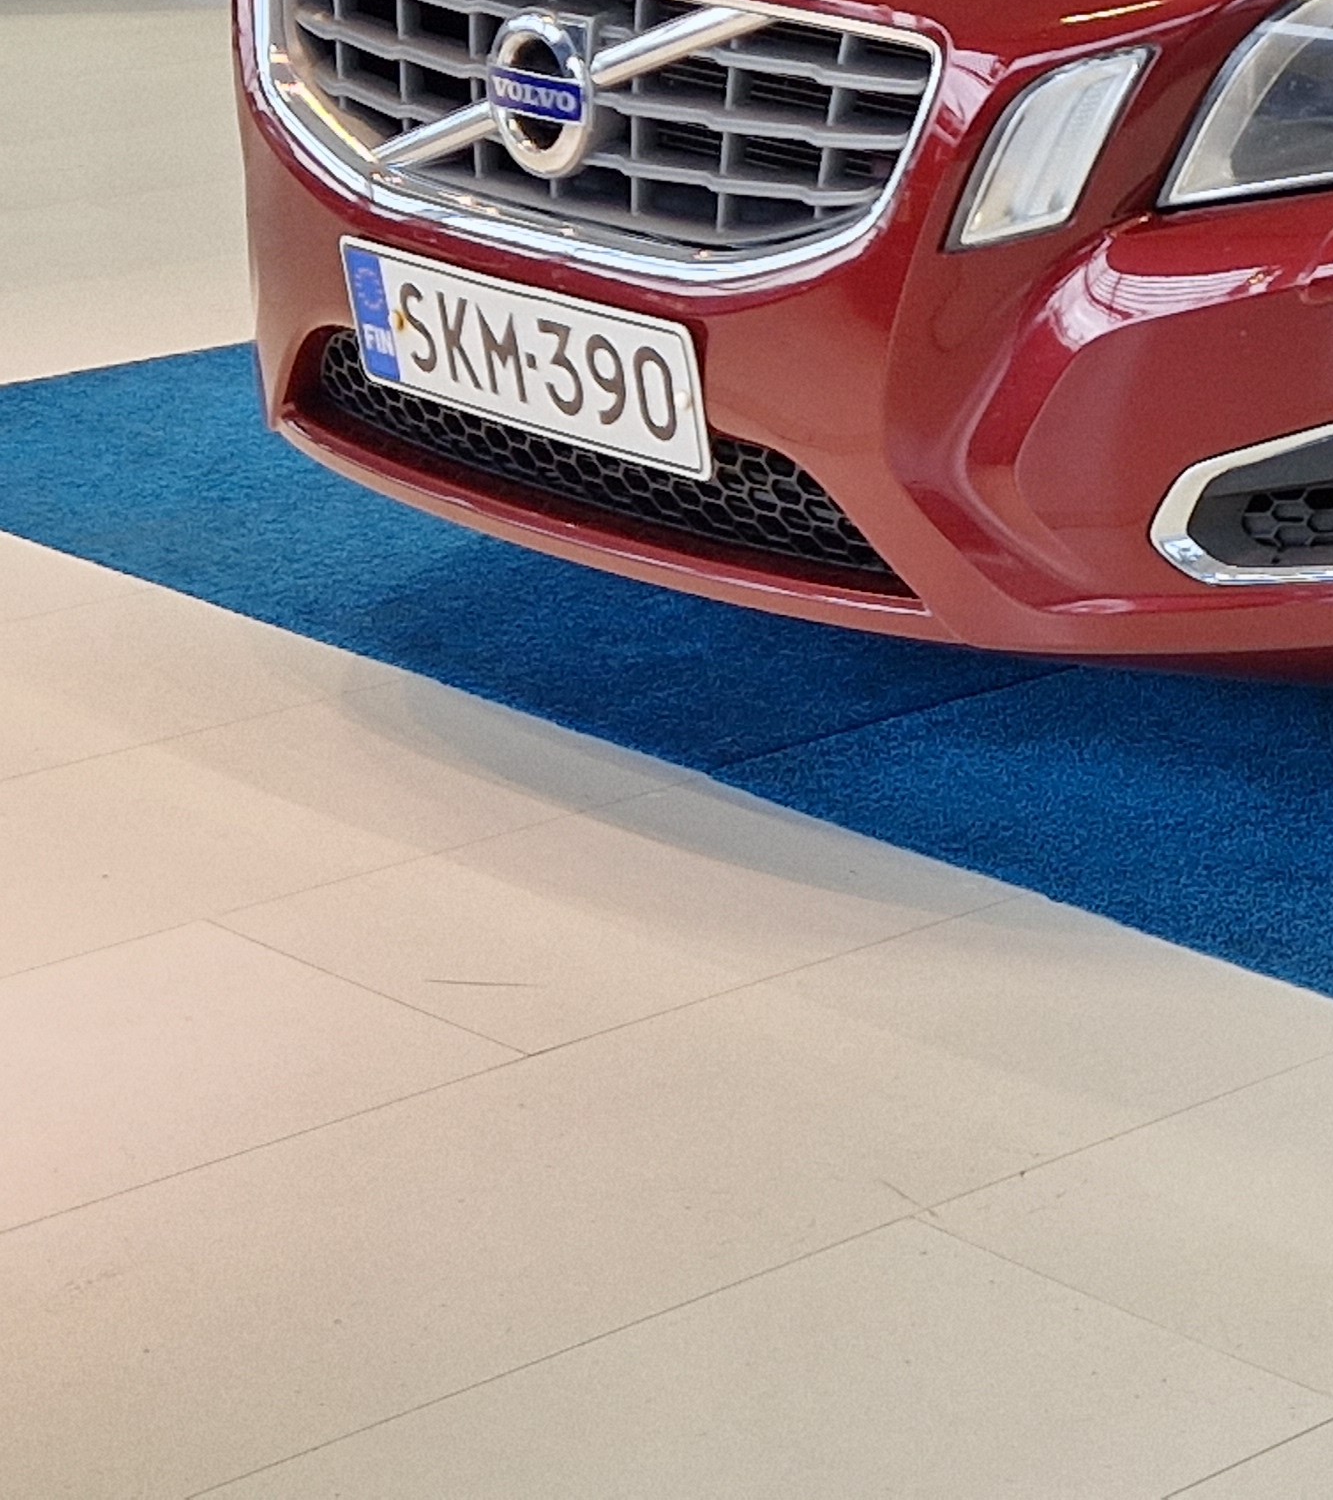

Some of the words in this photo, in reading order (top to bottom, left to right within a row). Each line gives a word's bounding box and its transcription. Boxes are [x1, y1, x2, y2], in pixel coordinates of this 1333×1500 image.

[491, 75, 577, 113] VOLVO
[363, 323, 395, 357] FIN
[399, 283, 678, 442] SKM-390
